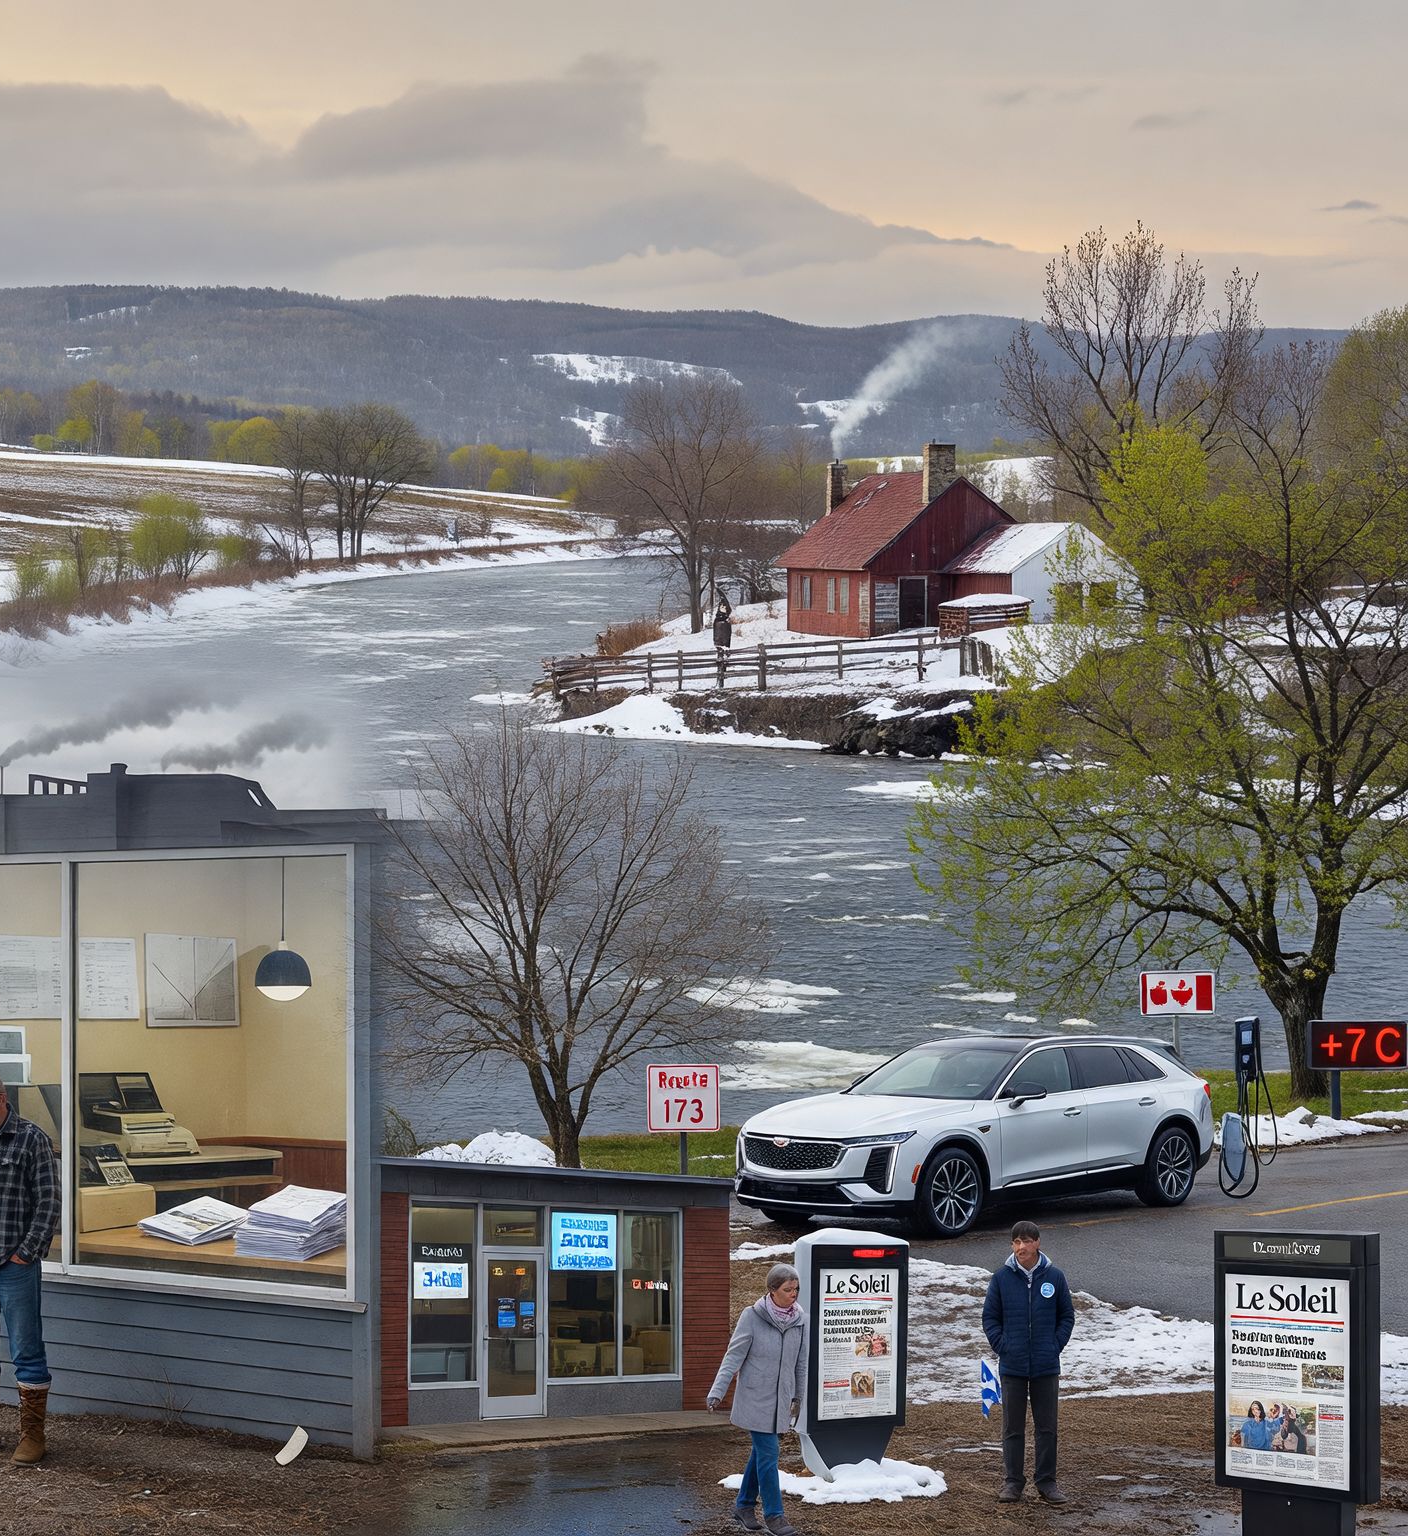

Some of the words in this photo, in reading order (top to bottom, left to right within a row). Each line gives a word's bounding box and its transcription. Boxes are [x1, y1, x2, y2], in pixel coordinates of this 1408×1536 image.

[664, 1098, 704, 1124] 173
[825, 1274, 846, 1294] Le
[848, 1273, 890, 1294] Soleil
[1235, 1282, 1265, 1311] Le
[1268, 1283, 1338, 1314] Soleil
